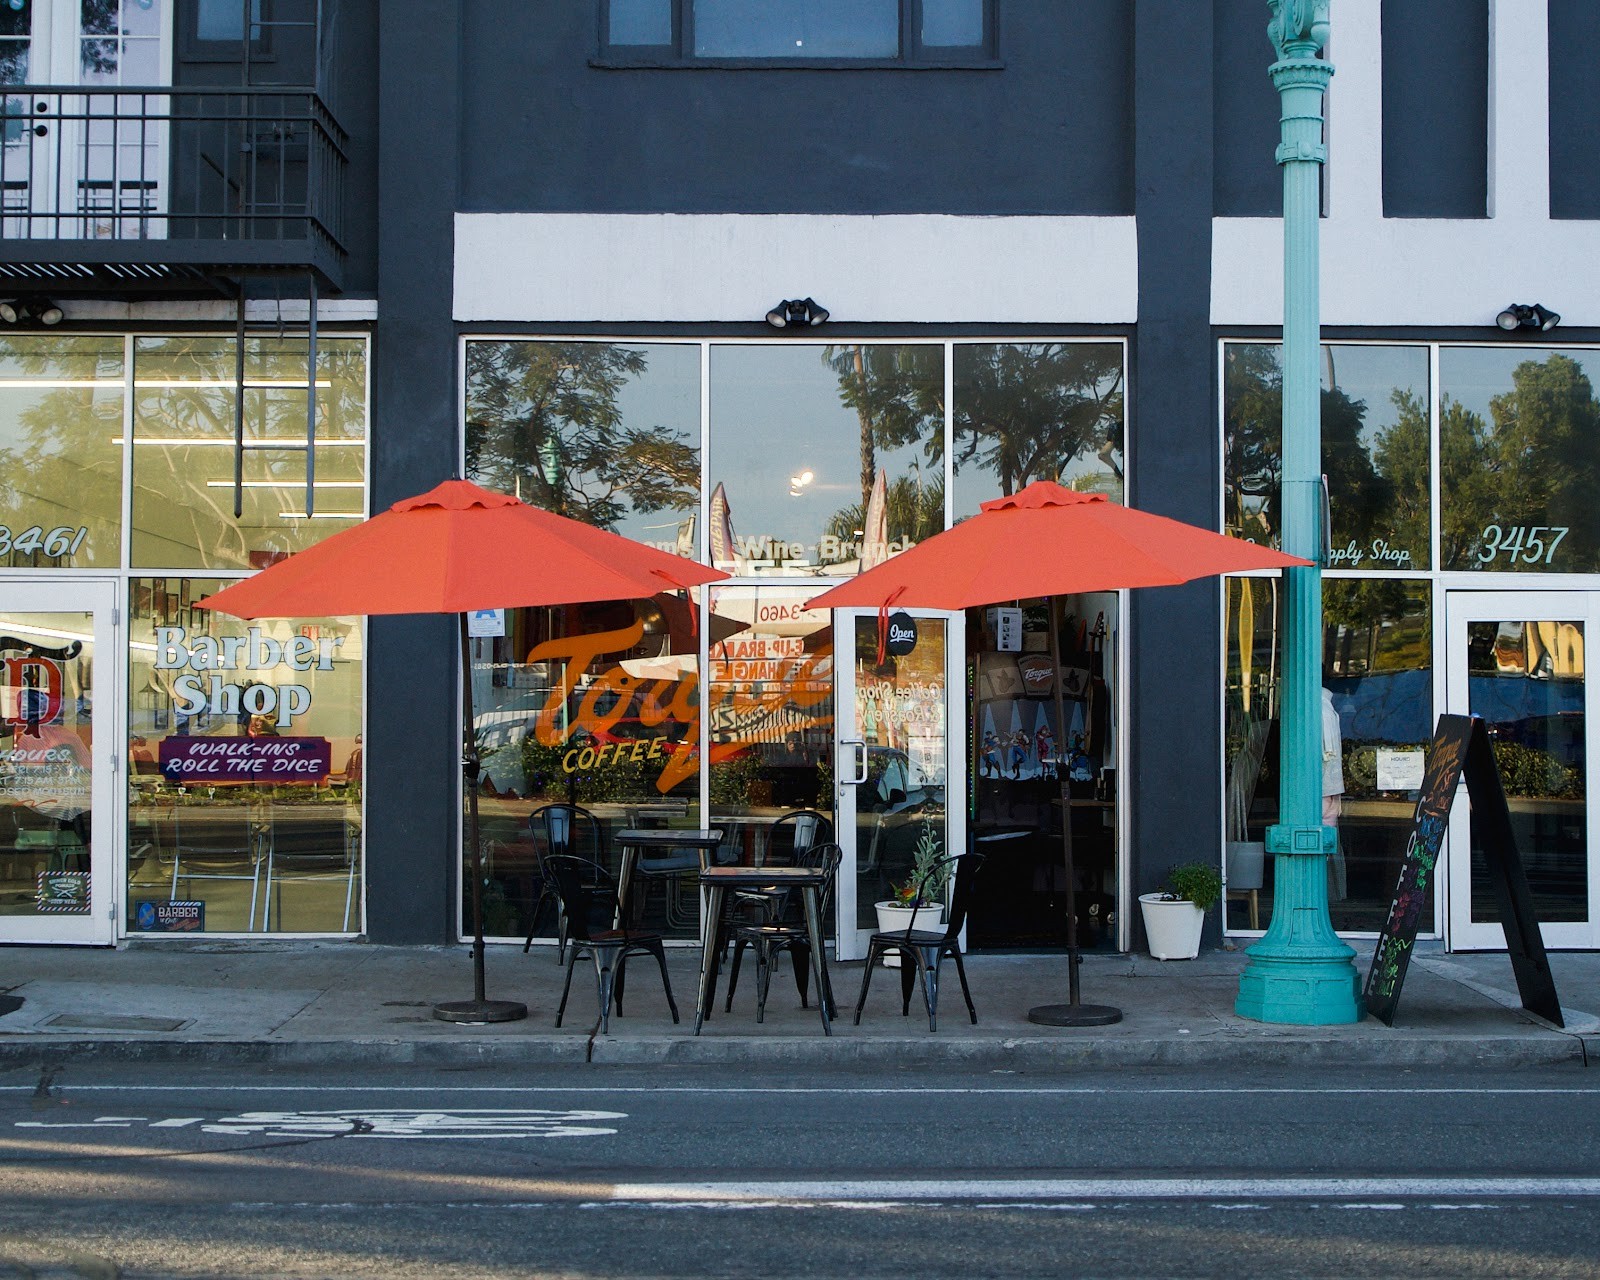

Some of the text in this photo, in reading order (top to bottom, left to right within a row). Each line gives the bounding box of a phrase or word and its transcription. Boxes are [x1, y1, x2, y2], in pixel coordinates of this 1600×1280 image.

[737, 535, 805, 559] Wine
[1330, 539, 1411, 566] pply Shop
[1478, 525, 1568, 564] 3457
[890, 624, 914, 642] Open
[153, 626, 346, 671] Barber
[173, 674, 312, 727] Shop
[189, 743, 301, 756] WALK-INS
[562, 736, 667, 774] COFFEE
[166, 759, 322, 772] ROLL THE DICE
[158, 907, 199, 918] BARBER
